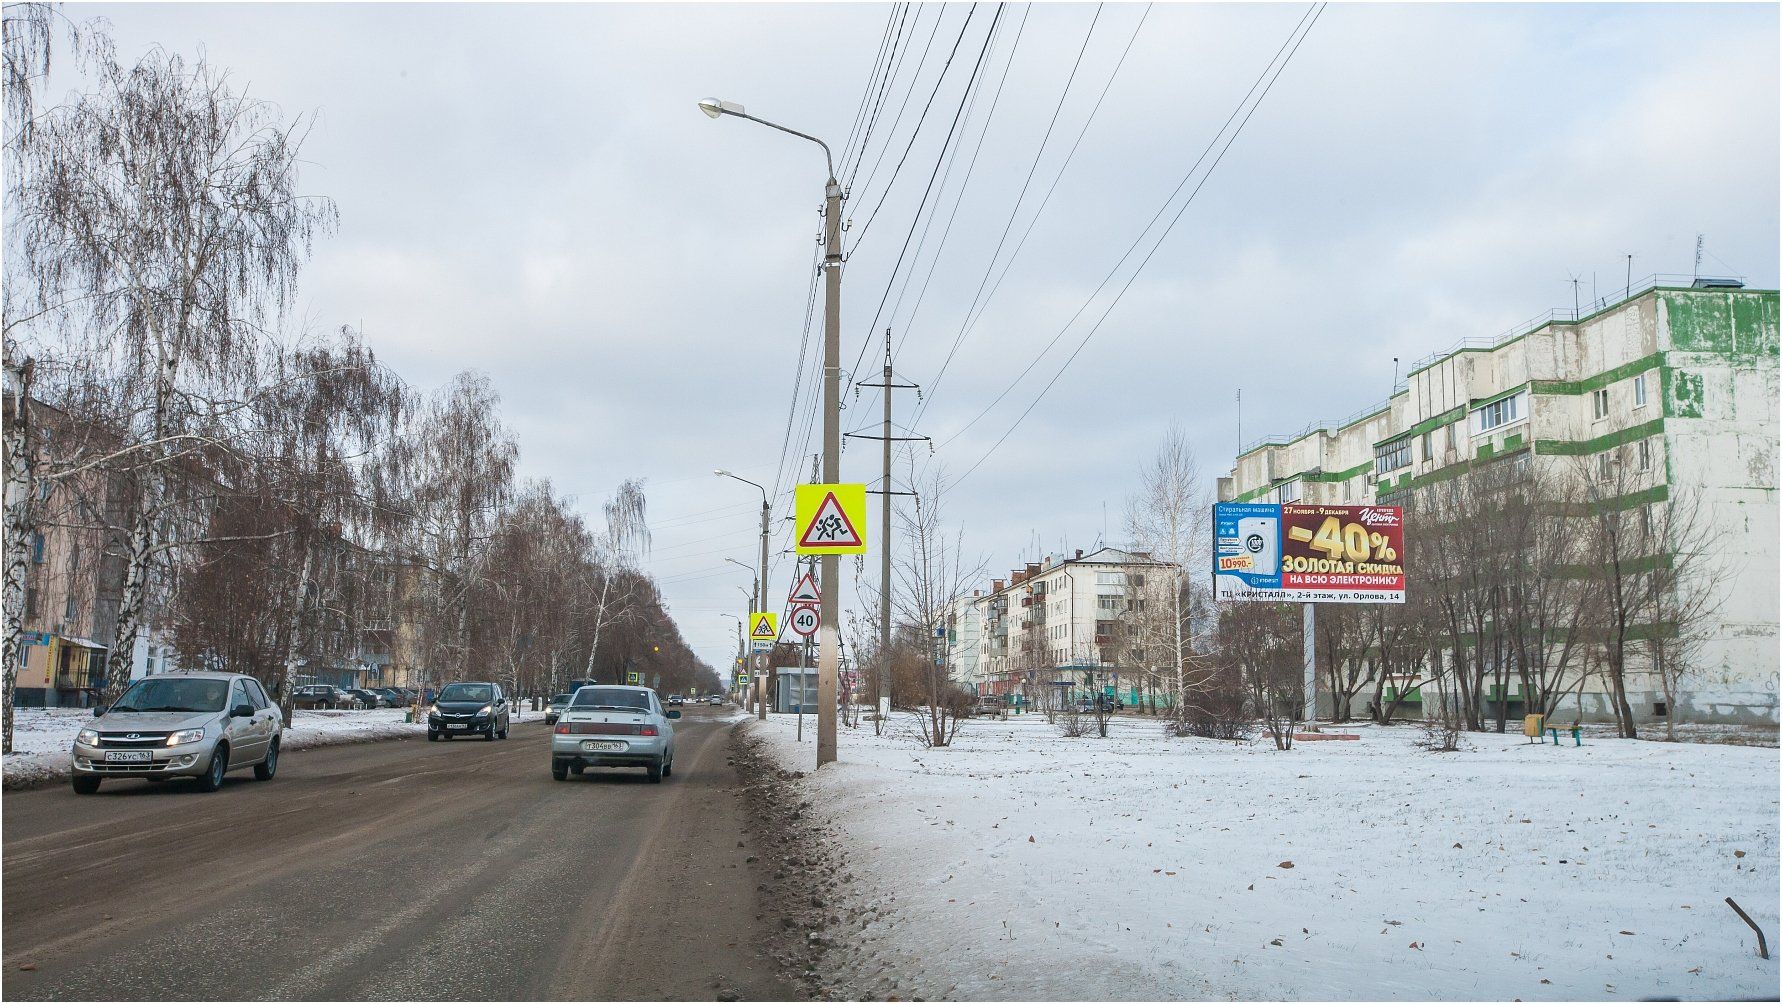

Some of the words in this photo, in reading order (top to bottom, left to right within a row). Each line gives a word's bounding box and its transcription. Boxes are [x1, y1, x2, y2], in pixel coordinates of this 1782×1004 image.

[1218, 506, 1252, 514] Стиральная
[1283, 506, 1294, 514] 27
[1288, 515, 1397, 562] -40%
[1282, 555, 1354, 573] ЗОЛОТАЯ
[1357, 562, 1404, 575] СКИДКА
[1289, 575, 1304, 584] НА
[1305, 575, 1328, 584] ВСЮ
[1329, 575, 1398, 585] ЭЛЕКТРОНИКУ
[1221, 590, 1232, 599] ТЦ
[1234, 591, 1295, 599] «КРИСТАЛЛ»,
[1297, 591, 1311, 599] 2-й
[1313, 592, 1336, 600] этаж,
[1338, 592, 1351, 600] ул.
[1353, 592, 1387, 601] Орлова,
[1389, 592, 1400, 600] 14
[797, 615, 813, 626] 40
